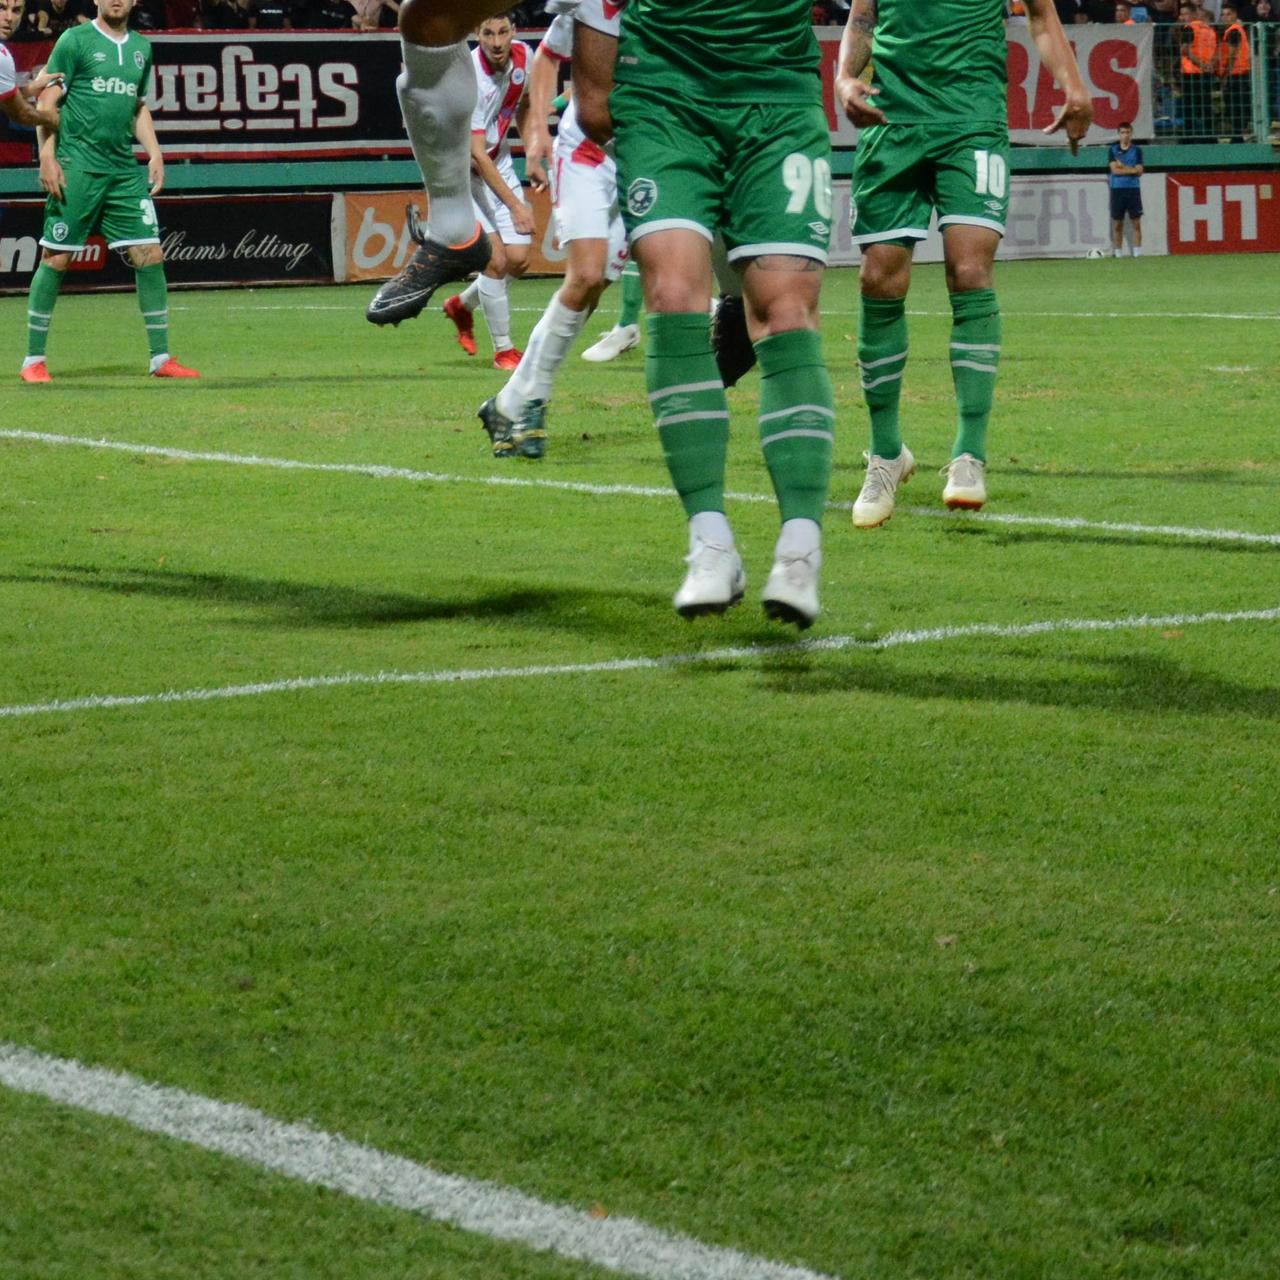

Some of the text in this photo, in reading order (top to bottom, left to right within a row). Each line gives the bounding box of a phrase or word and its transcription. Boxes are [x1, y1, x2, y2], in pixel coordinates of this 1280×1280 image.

[974, 150, 1006, 199] 10
[1003, 188, 1106, 247] EAL
[1178, 184, 1258, 242] HT
[233, 228, 312, 271] betting
